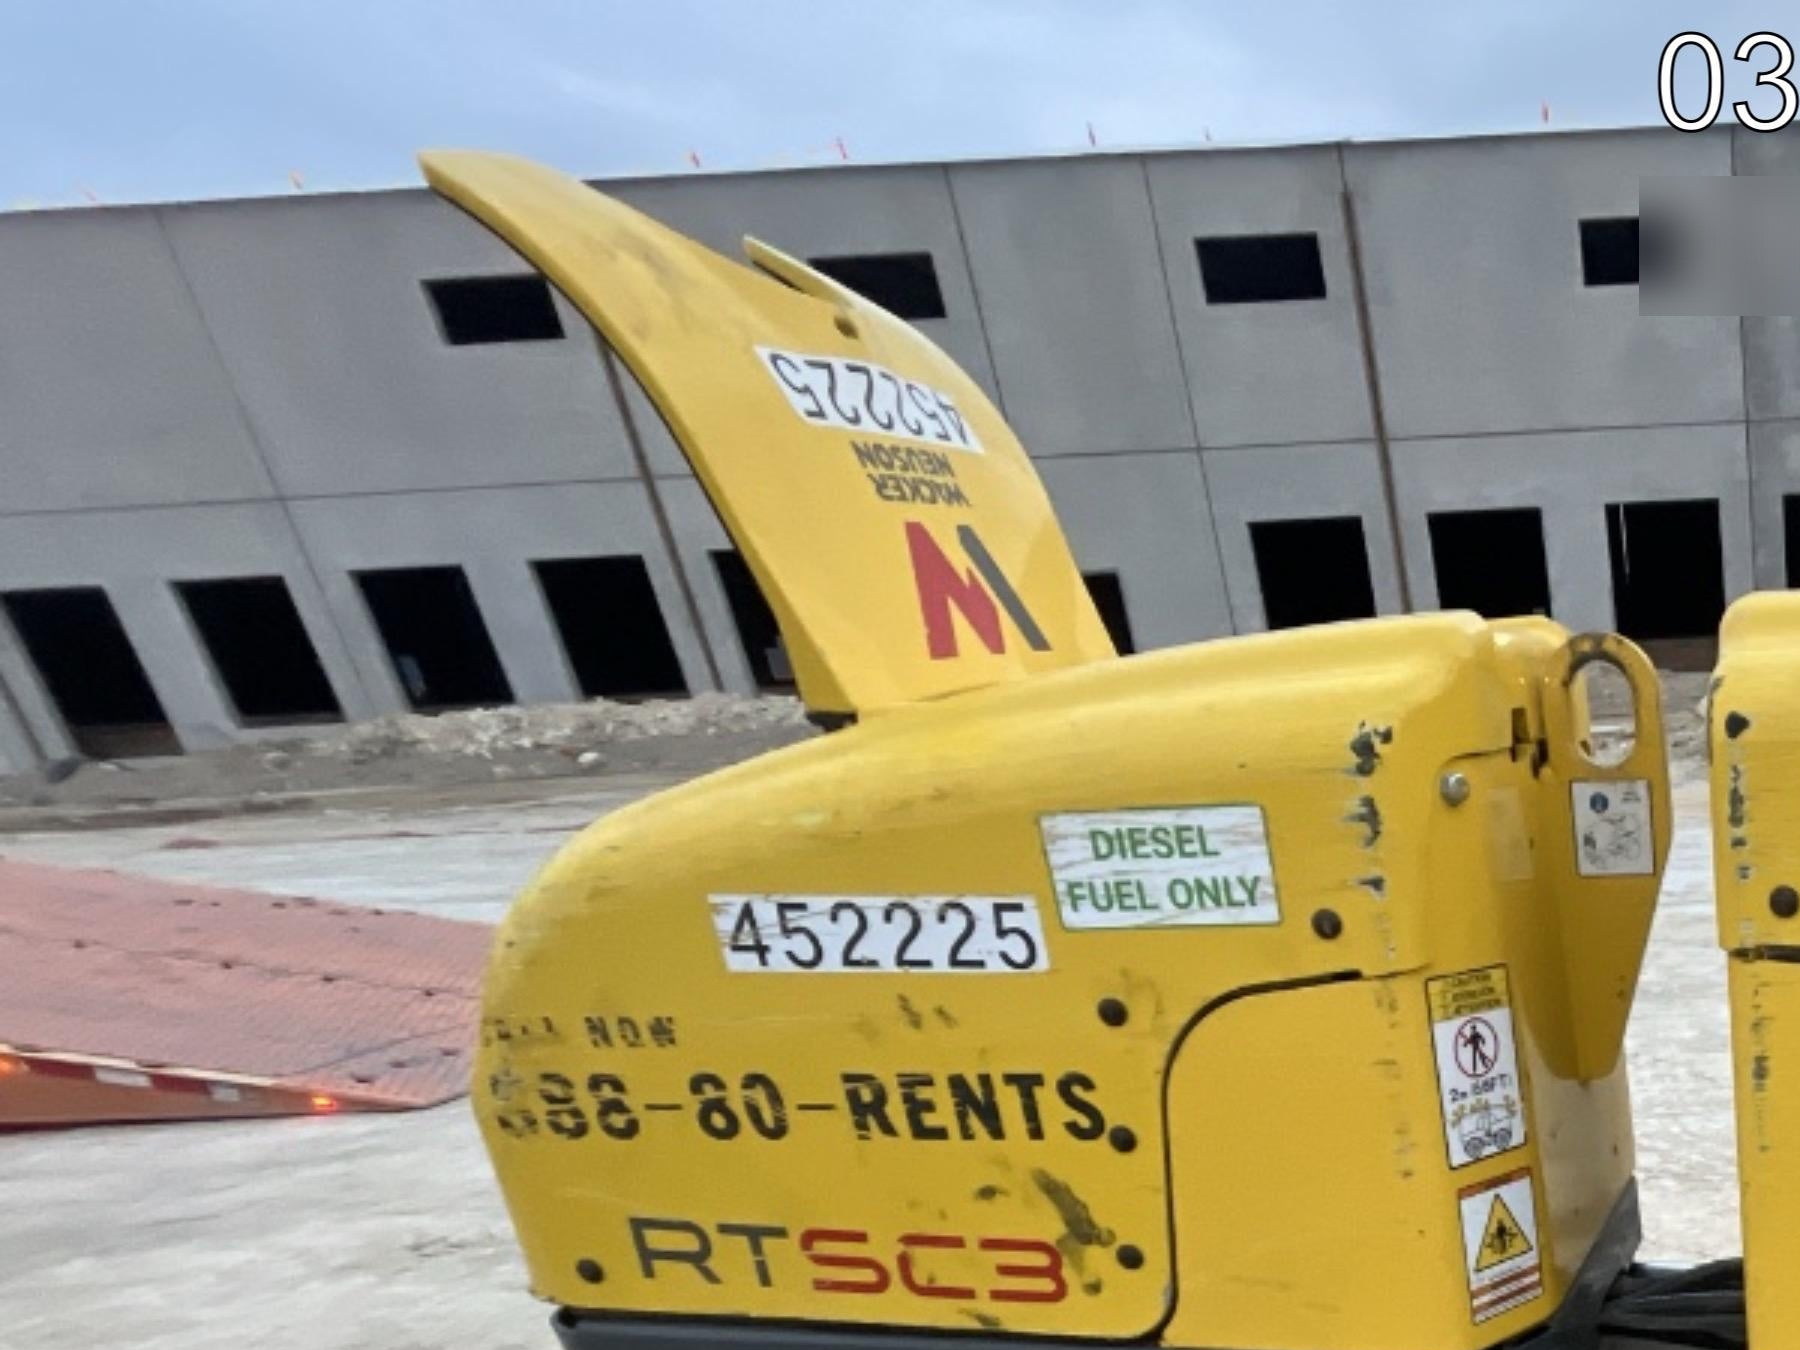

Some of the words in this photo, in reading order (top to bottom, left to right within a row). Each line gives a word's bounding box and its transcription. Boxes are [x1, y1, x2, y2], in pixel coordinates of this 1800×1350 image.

[768, 353, 969, 444] 452225
[850, 440, 955, 478] NEUSON
[866, 473, 972, 507] WACKER
[1088, 824, 1221, 861] DIESEL
[1066, 880, 1160, 912] FUEL
[1167, 875, 1261, 910] ONLY
[729, 901, 1038, 969] 452225
[585, 1016, 677, 1048] NOW
[629, 1216, 1069, 1304] RTSC3
